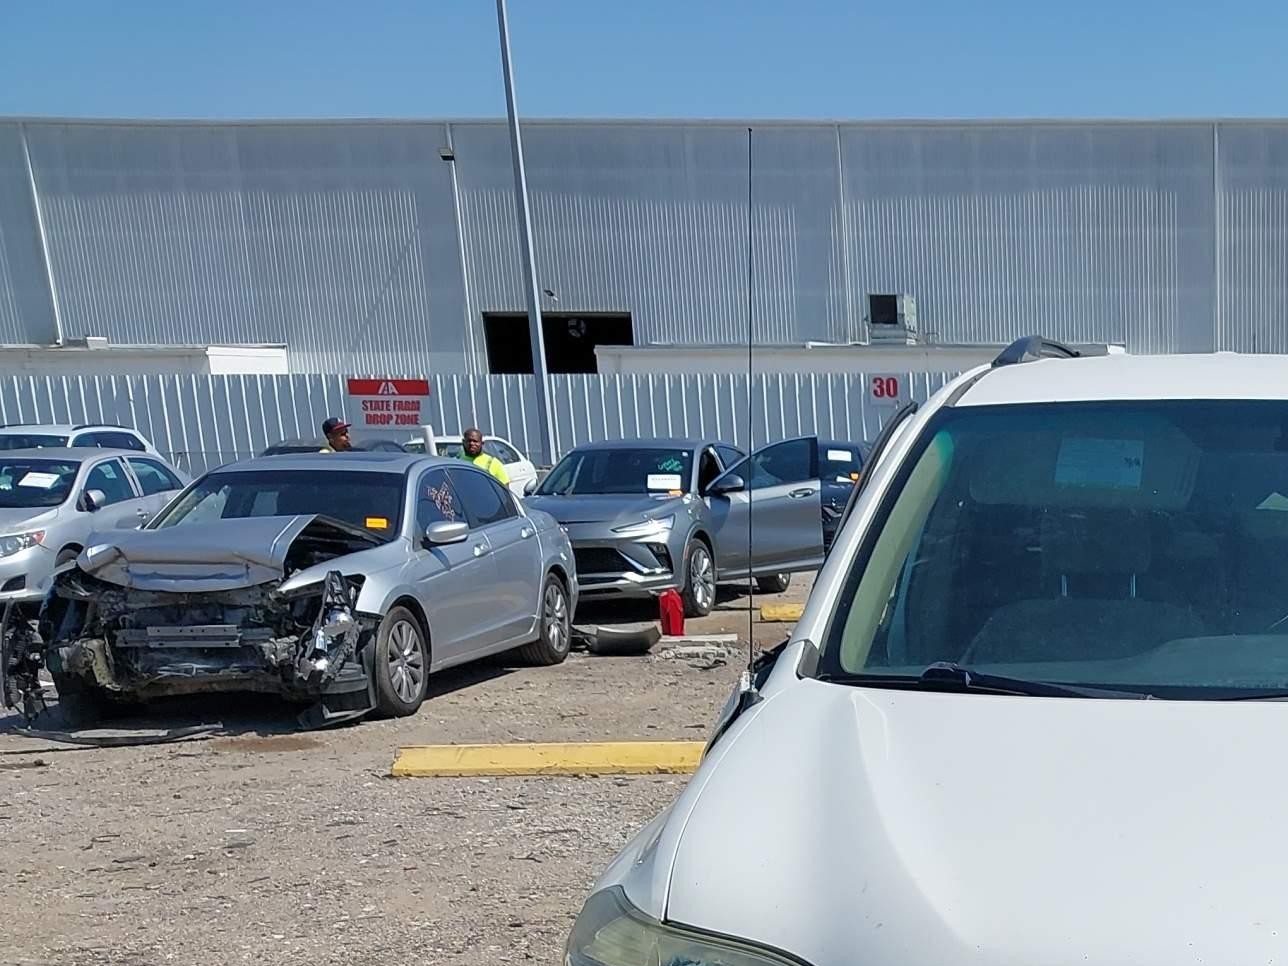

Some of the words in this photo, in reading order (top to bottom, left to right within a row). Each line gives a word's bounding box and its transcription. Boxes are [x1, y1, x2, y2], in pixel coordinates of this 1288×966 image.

[873, 377, 898, 398] 30
[361, 400, 391, 411] STATE
[393, 400, 420, 411] FARM
[365, 413, 393, 425] DROP
[395, 414, 419, 425] ZONE
